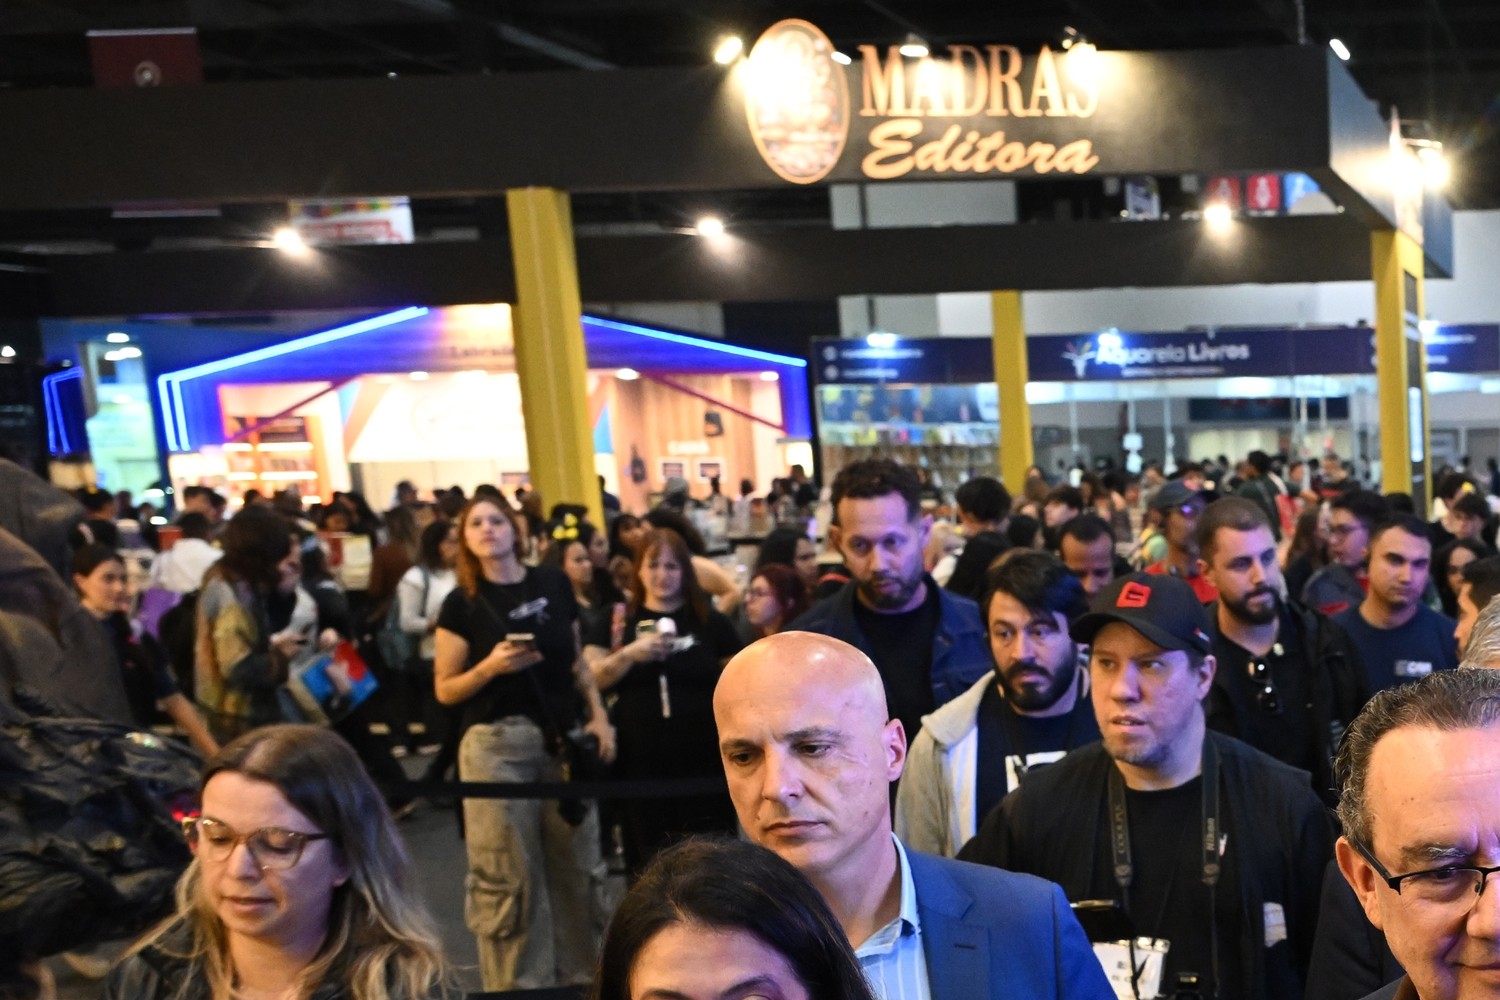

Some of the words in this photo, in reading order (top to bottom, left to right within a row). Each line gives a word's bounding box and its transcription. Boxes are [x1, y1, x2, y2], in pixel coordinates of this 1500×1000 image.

[857, 44, 1098, 118] MADRAS
[862, 118, 1099, 179] Editora
[1188, 342, 1249, 361] Livros
[1204, 817, 1216, 852] Nikon
